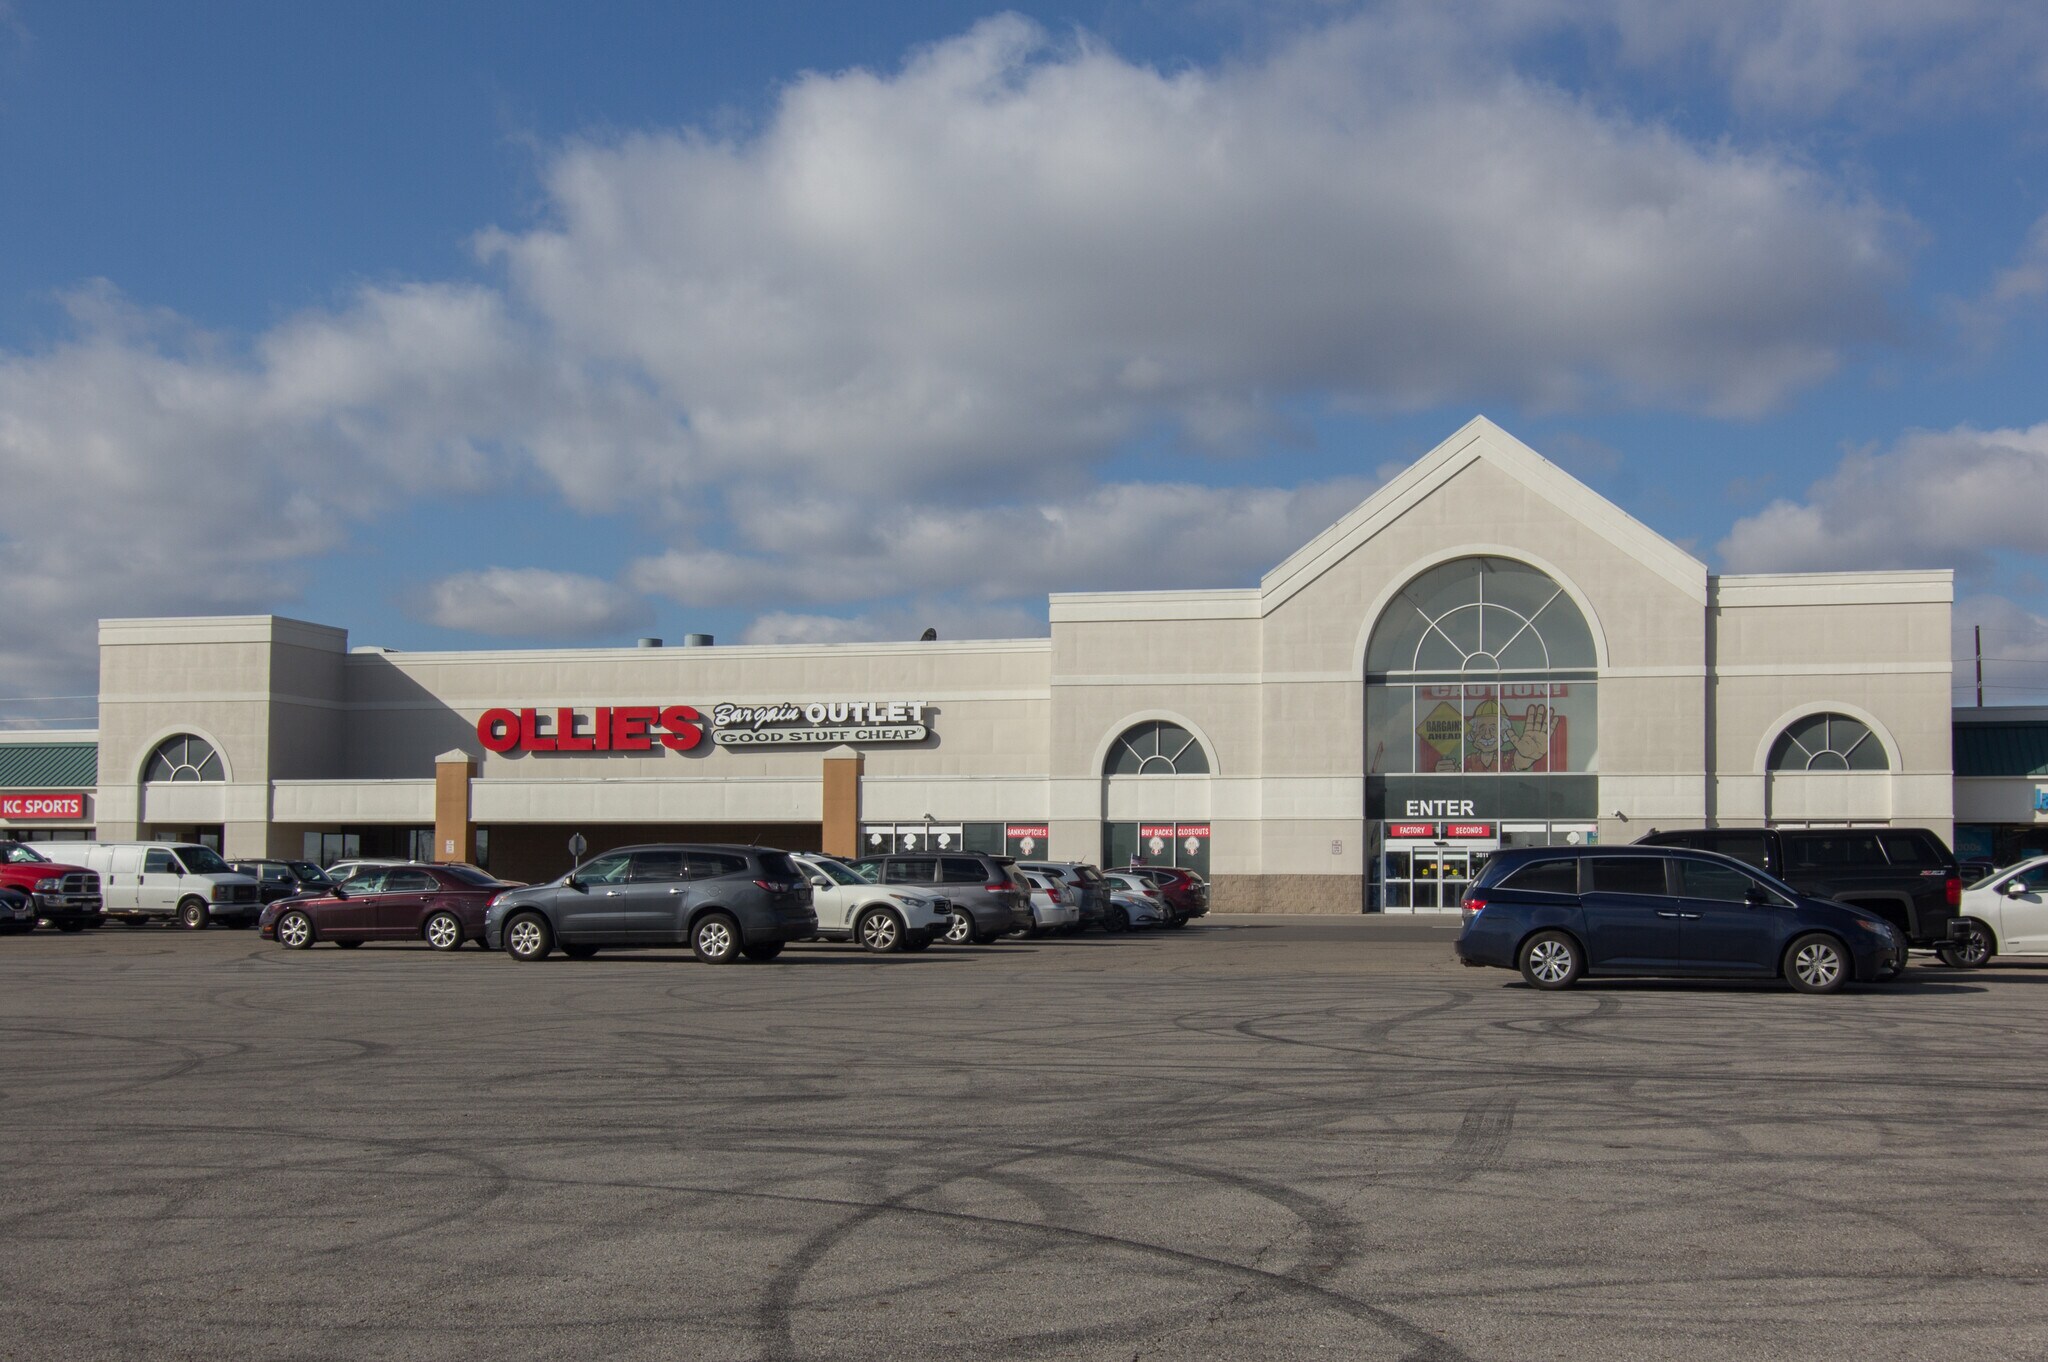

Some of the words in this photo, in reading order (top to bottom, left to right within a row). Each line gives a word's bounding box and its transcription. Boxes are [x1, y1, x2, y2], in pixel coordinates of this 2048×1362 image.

[714, 702, 801, 732] Bargain
[805, 701, 927, 723] OUTLET
[477, 705, 702, 752] OLLIE'S
[789, 731, 850, 742] STUFF
[3, 800, 22, 813] KC
[25, 799, 79, 813] SPORTS
[1406, 800, 1475, 816] ENTER
[1141, 828, 1153, 836] BUY
[1154, 828, 1173, 836] BACKS
[1400, 826, 1425, 834] FACTORY
[1455, 826, 1483, 834] SECONDS
